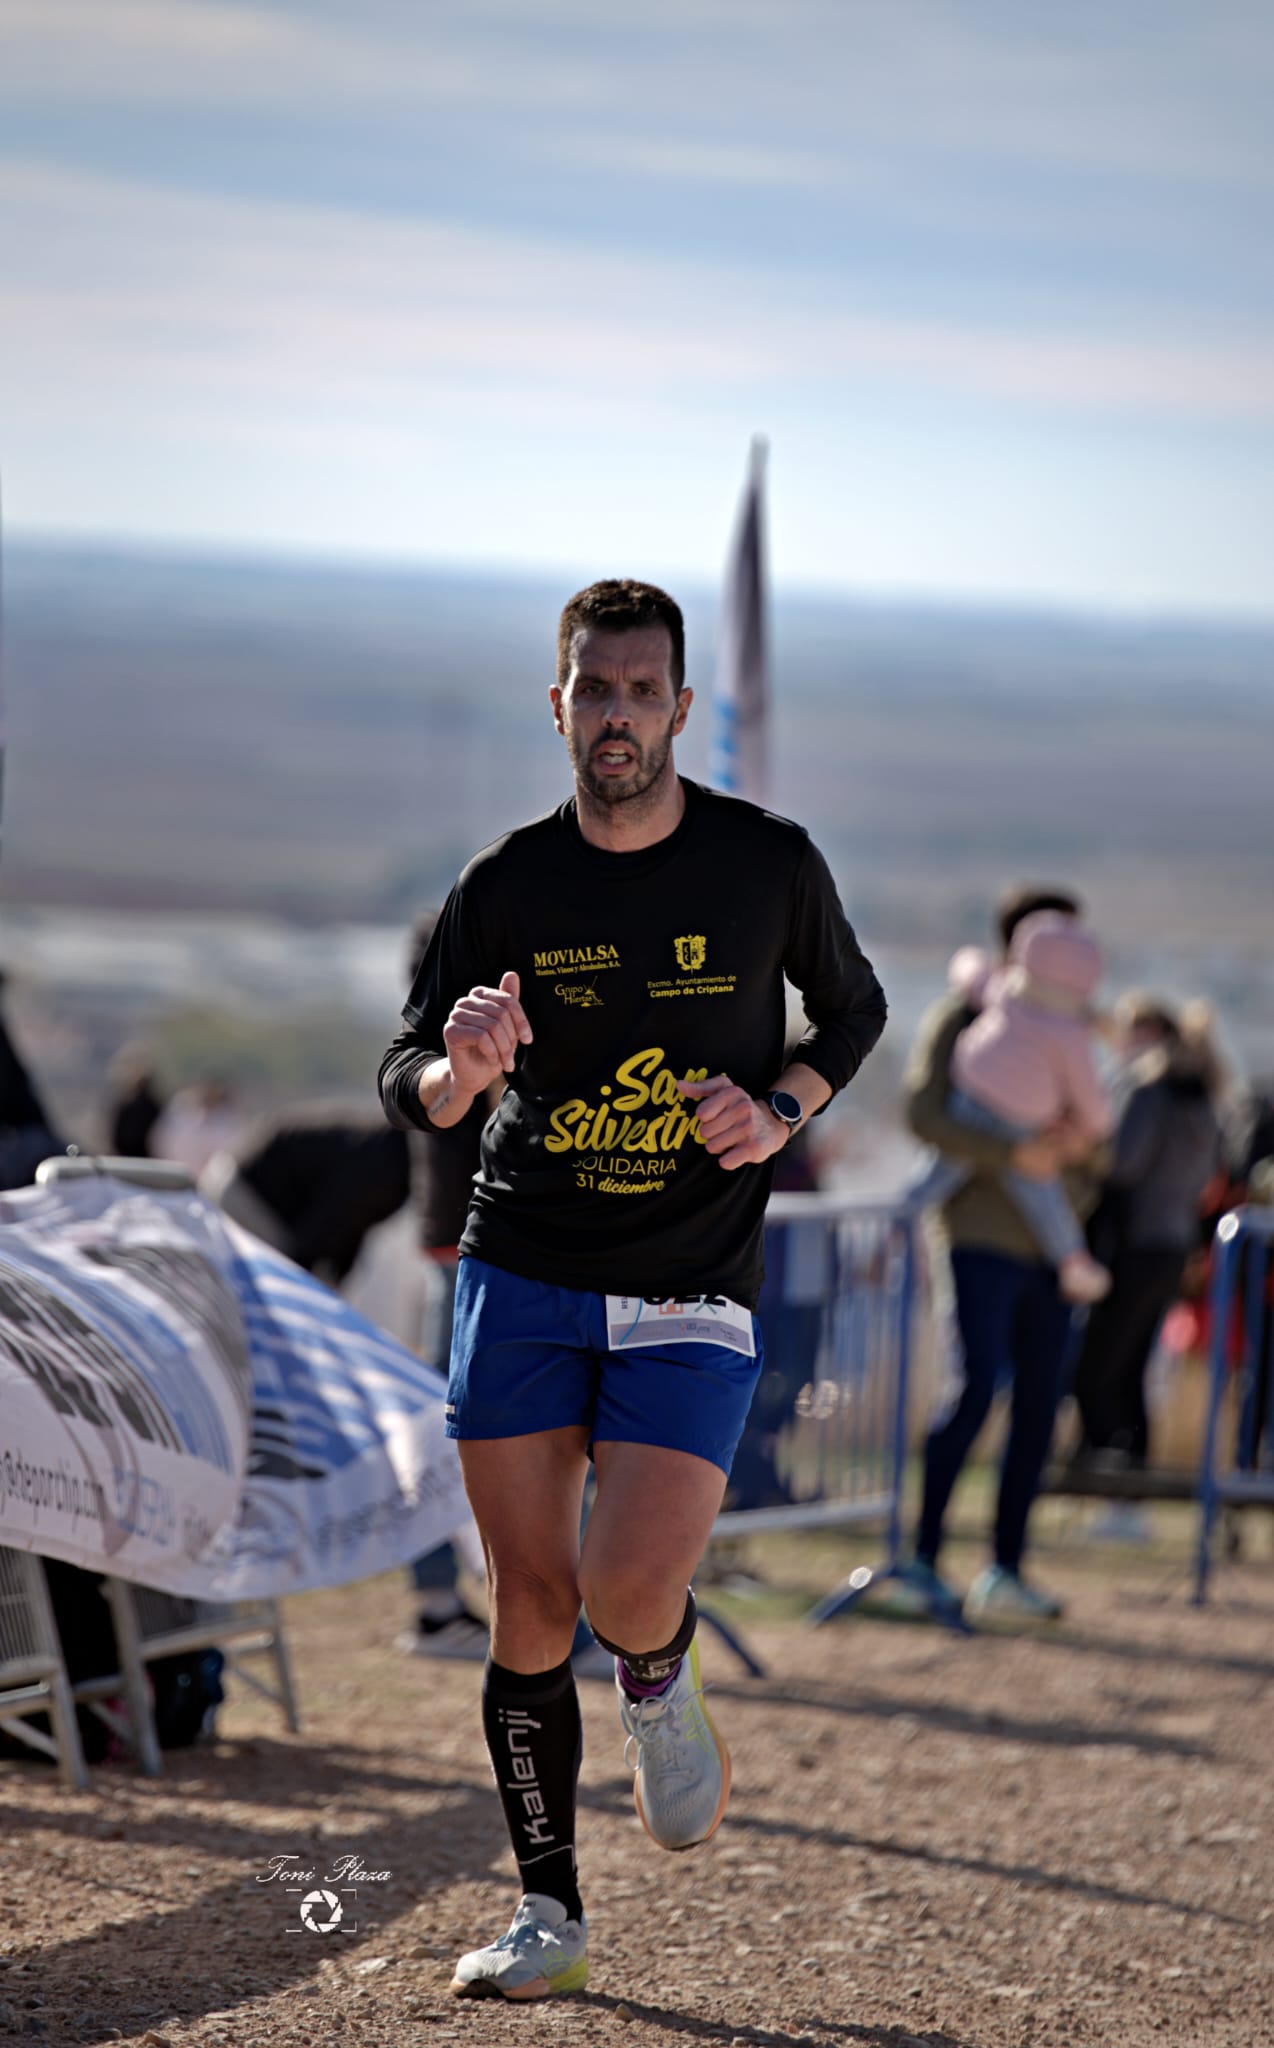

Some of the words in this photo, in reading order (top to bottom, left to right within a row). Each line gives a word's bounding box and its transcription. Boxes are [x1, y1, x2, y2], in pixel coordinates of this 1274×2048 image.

[533, 943, 620, 968] MOVIALSA
[675, 976, 726, 986] Ayuntamiento
[554, 984, 584, 998] Grupo
[650, 988, 681, 998] Campo
[683, 987, 695, 995] de
[697, 985, 734, 995] Criptana
[576, 1173, 594, 1189] 31
[598, 1176, 665, 1194] diciembre
[498, 1708, 555, 1845] kalenji
